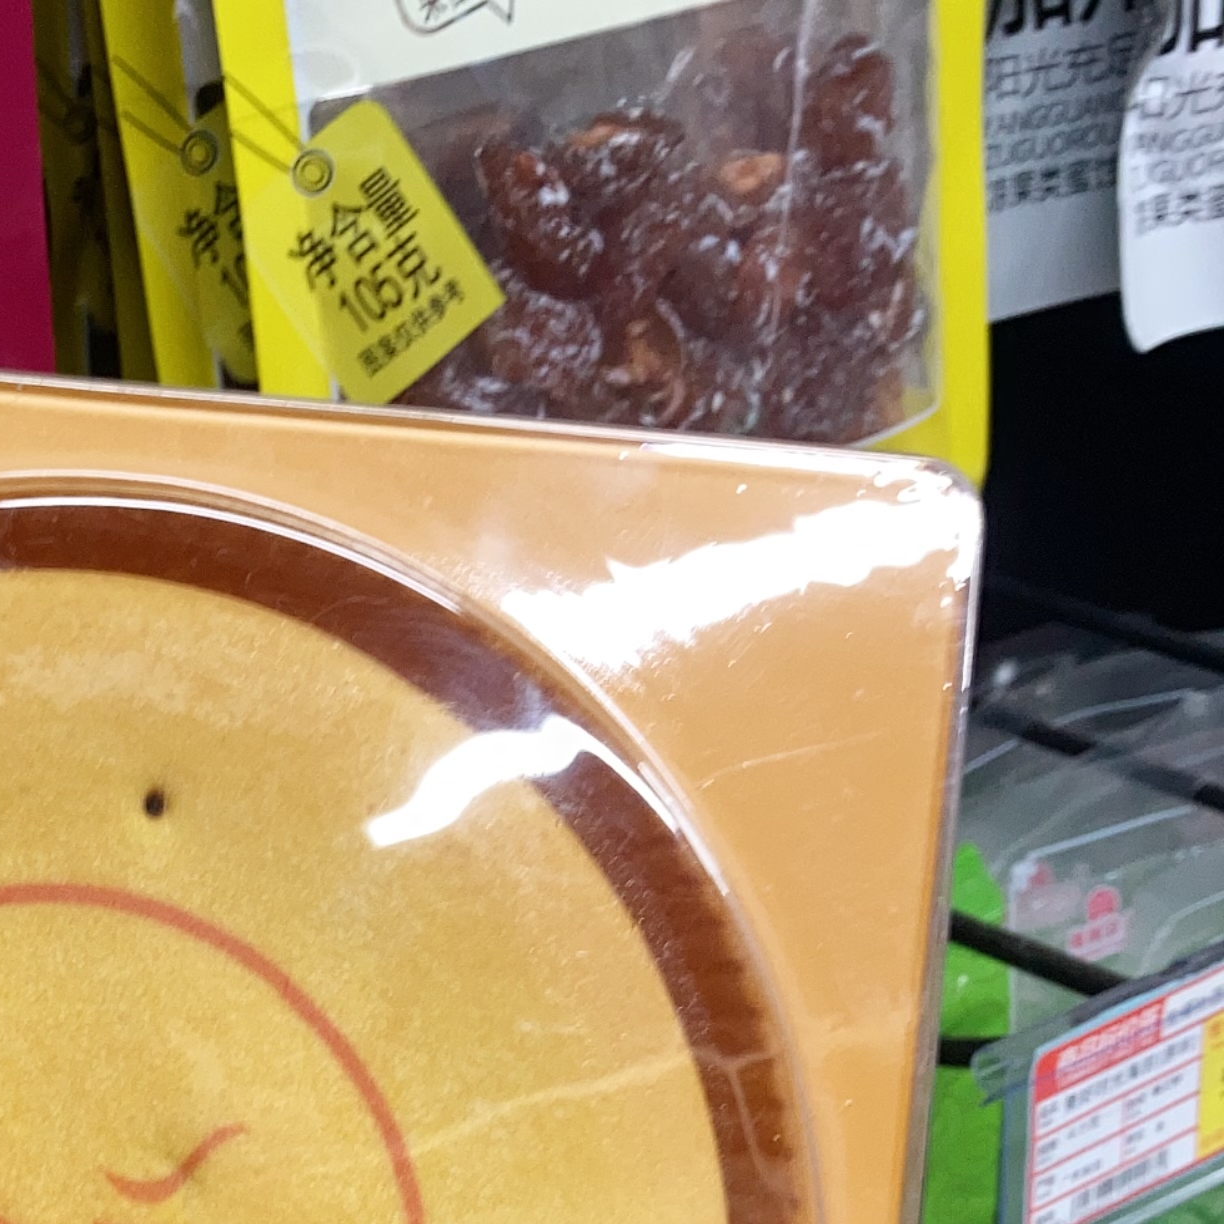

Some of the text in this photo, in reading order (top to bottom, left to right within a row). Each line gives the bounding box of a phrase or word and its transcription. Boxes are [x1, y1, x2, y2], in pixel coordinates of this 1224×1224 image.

[288, 167, 421, 290] 净含量
[337, 231, 442, 333] 105克
